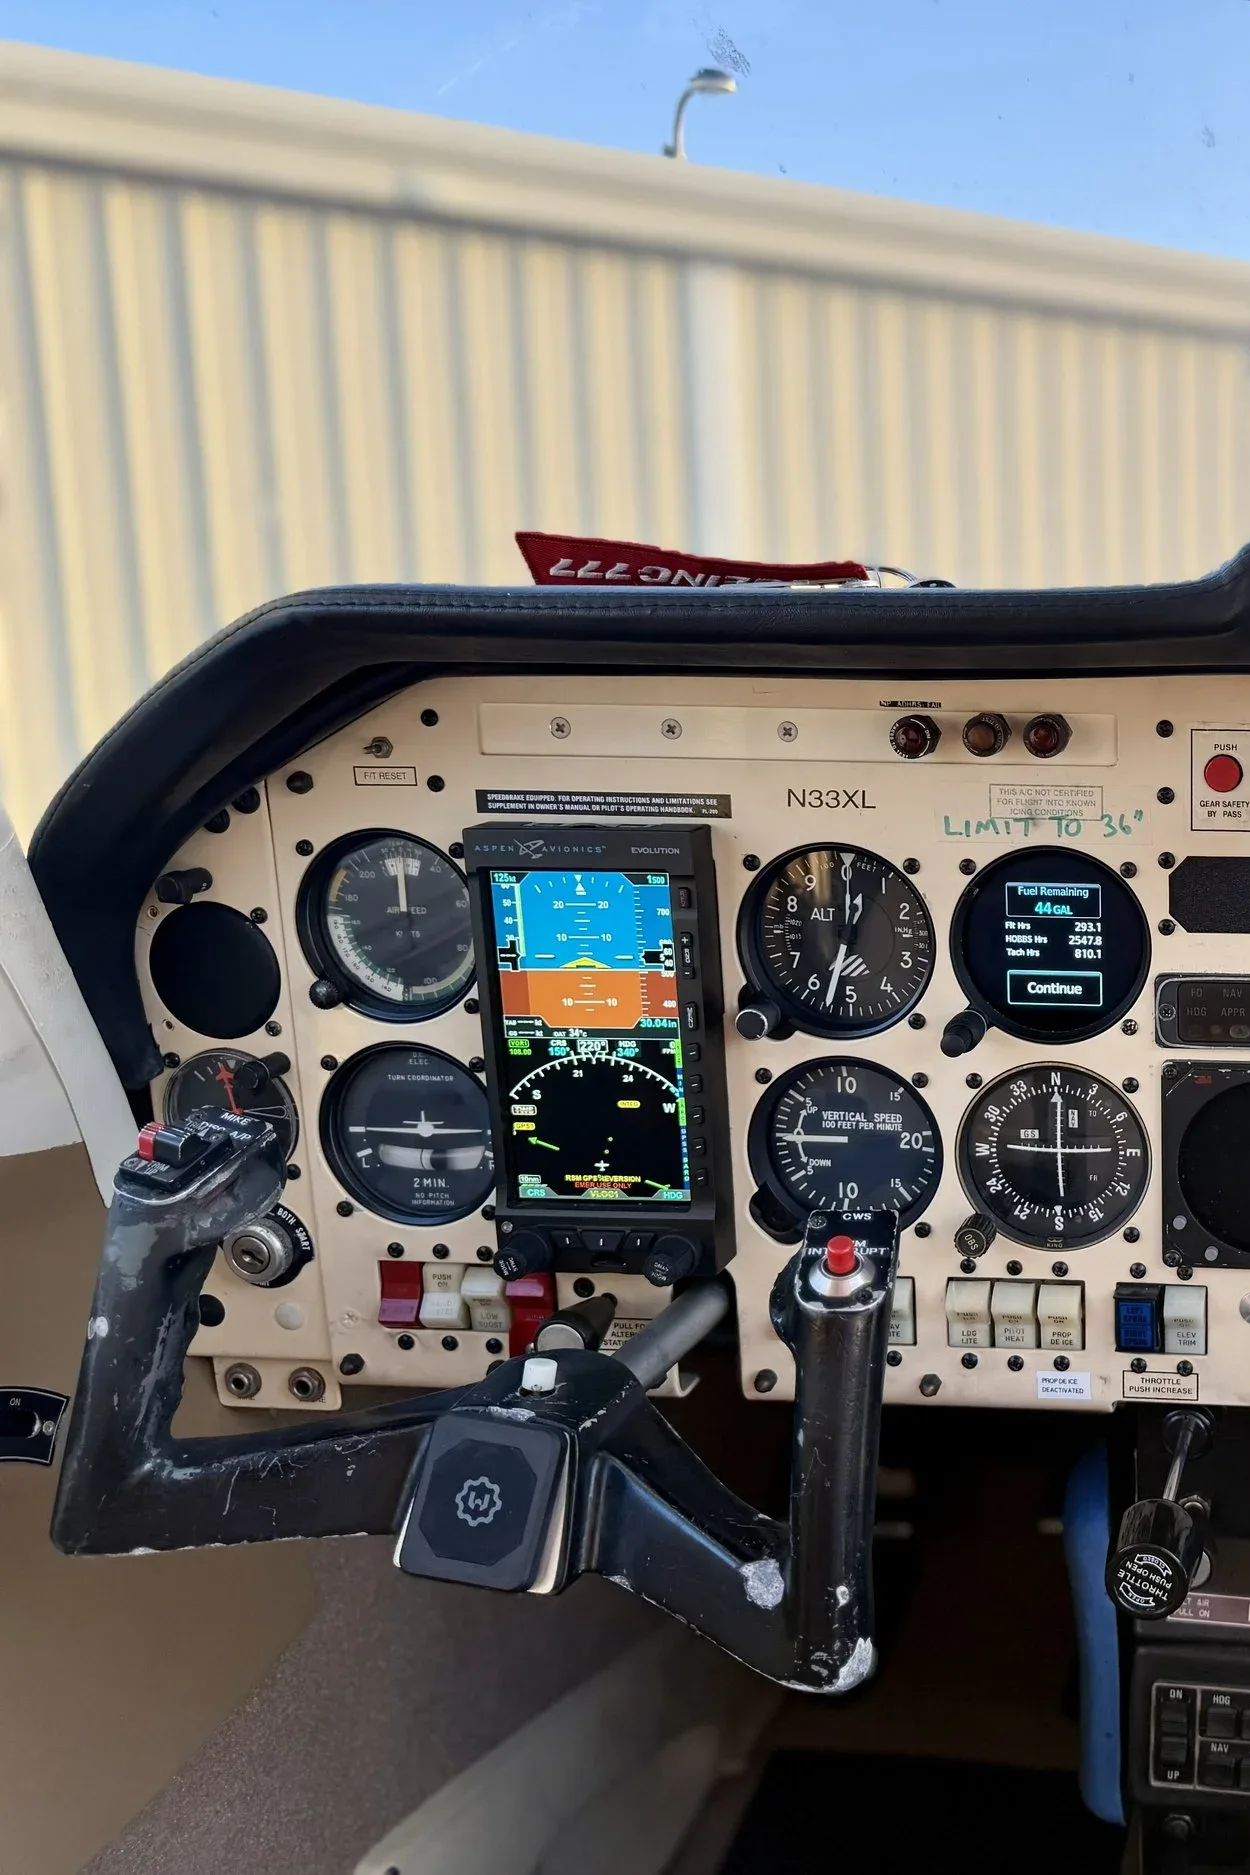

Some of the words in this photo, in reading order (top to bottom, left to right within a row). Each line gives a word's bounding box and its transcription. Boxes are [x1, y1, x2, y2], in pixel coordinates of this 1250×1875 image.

[1213, 743, 1238, 751] PUSH
[363, 771, 379, 780] F/T
[378, 771, 407, 781] RESET
[486, 793, 526, 802] SPEEDBRAKE
[525, 794, 558, 802] EQUIPPED.
[557, 794, 571, 803] FOR
[570, 795, 605, 803] OPERATING
[605, 795, 651, 804] INSTRUCTIONS
[650, 797, 665, 805] AND
[665, 797, 705, 806] LIMITATIONS
[705, 798, 719, 806] SEE
[787, 788, 877, 809] N33XL
[999, 788, 1018, 797] THIS
[1018, 789, 1034, 797] A/C
[1034, 789, 1051, 798] NOT
[1052, 789, 1095, 798] CERTIFIED
[487, 802, 528, 810] SUPPLEMENT
[535, 803, 564, 811] OWNER'S
[564, 803, 591, 812] MANUAL
[591, 804, 601, 812] OR
[600, 804, 625, 812] PILOT'S
[625, 805, 660, 813] OPERATING
[659, 806, 696, 814] HANDBOOK.
[996, 798, 1014, 807] FOR
[1015, 798, 1044, 808] FLIGHT
[1044, 799, 1064, 808] INTO
[1065, 799, 1097, 808] KNOWN
[1199, 800, 1221, 808] GEAR
[1222, 800, 1250, 809] SAFETY
[1009, 808, 1033, 817] ICING
[1033, 808, 1084, 818] CONDITIONS
[1207, 810, 1217, 818] BY
[1222, 810, 1243, 818] PASS
[943, 815, 1033, 838] LIMIT
[1047, 815, 1083, 837] TO
[630, 846, 681, 855] EVOLUTION
[1017, 885, 1039, 896] Fuel
[1039, 886, 1090, 899] Remaining
[810, 907, 836, 922] ALT
[1034, 901, 1052, 915] 44
[1052, 905, 1074, 916] GAL
[1004, 921, 1017, 930] Flt
[1016, 921, 1031, 930] Hrs
[1074, 921, 1102, 932] 293.1
[1005, 934, 1033, 944] HOBBS
[1034, 935, 1049, 944] Hrs
[1068, 935, 1103, 946] 2547.8
[1005, 947, 1026, 957] Tach
[1026, 948, 1040, 957] Hrs
[1074, 948, 1102, 960] 810.1
[1026, 981, 1083, 995] Continue
[579, 1041, 606, 1052] 220°
[407, 1074, 454, 1082] COORDINATOR
[836, 1076, 857, 1094] 10
[220, 1112, 250, 1125] MIKE
[821, 1110, 868, 1123] VERTICAL
[873, 1112, 903, 1124] SPEED
[821, 1120, 836, 1129] 100
[837, 1121, 857, 1130] FEET
[858, 1121, 874, 1131] PER
[876, 1122, 903, 1132] MINUTE
[899, 1131, 923, 1150] 20
[838, 1181, 859, 1199] 10
[277, 1207, 297, 1226] BOTH
[294, 1227, 311, 1251] SMART
[963, 1233, 980, 1251] OBS
[1139, 1377, 1182, 1386] THROTTLE
[1128, 1385, 1151, 1394] PUSH
[1152, 1386, 1193, 1395] INCREASE
[1125, 1559, 1150, 1577] OPEN
[1116, 1567, 1169, 1602] THROTTLE
[1148, 1572, 1173, 1590] PUSH
[1212, 1694, 1231, 1705] HDG
[1210, 1743, 1229, 1753] NAV
